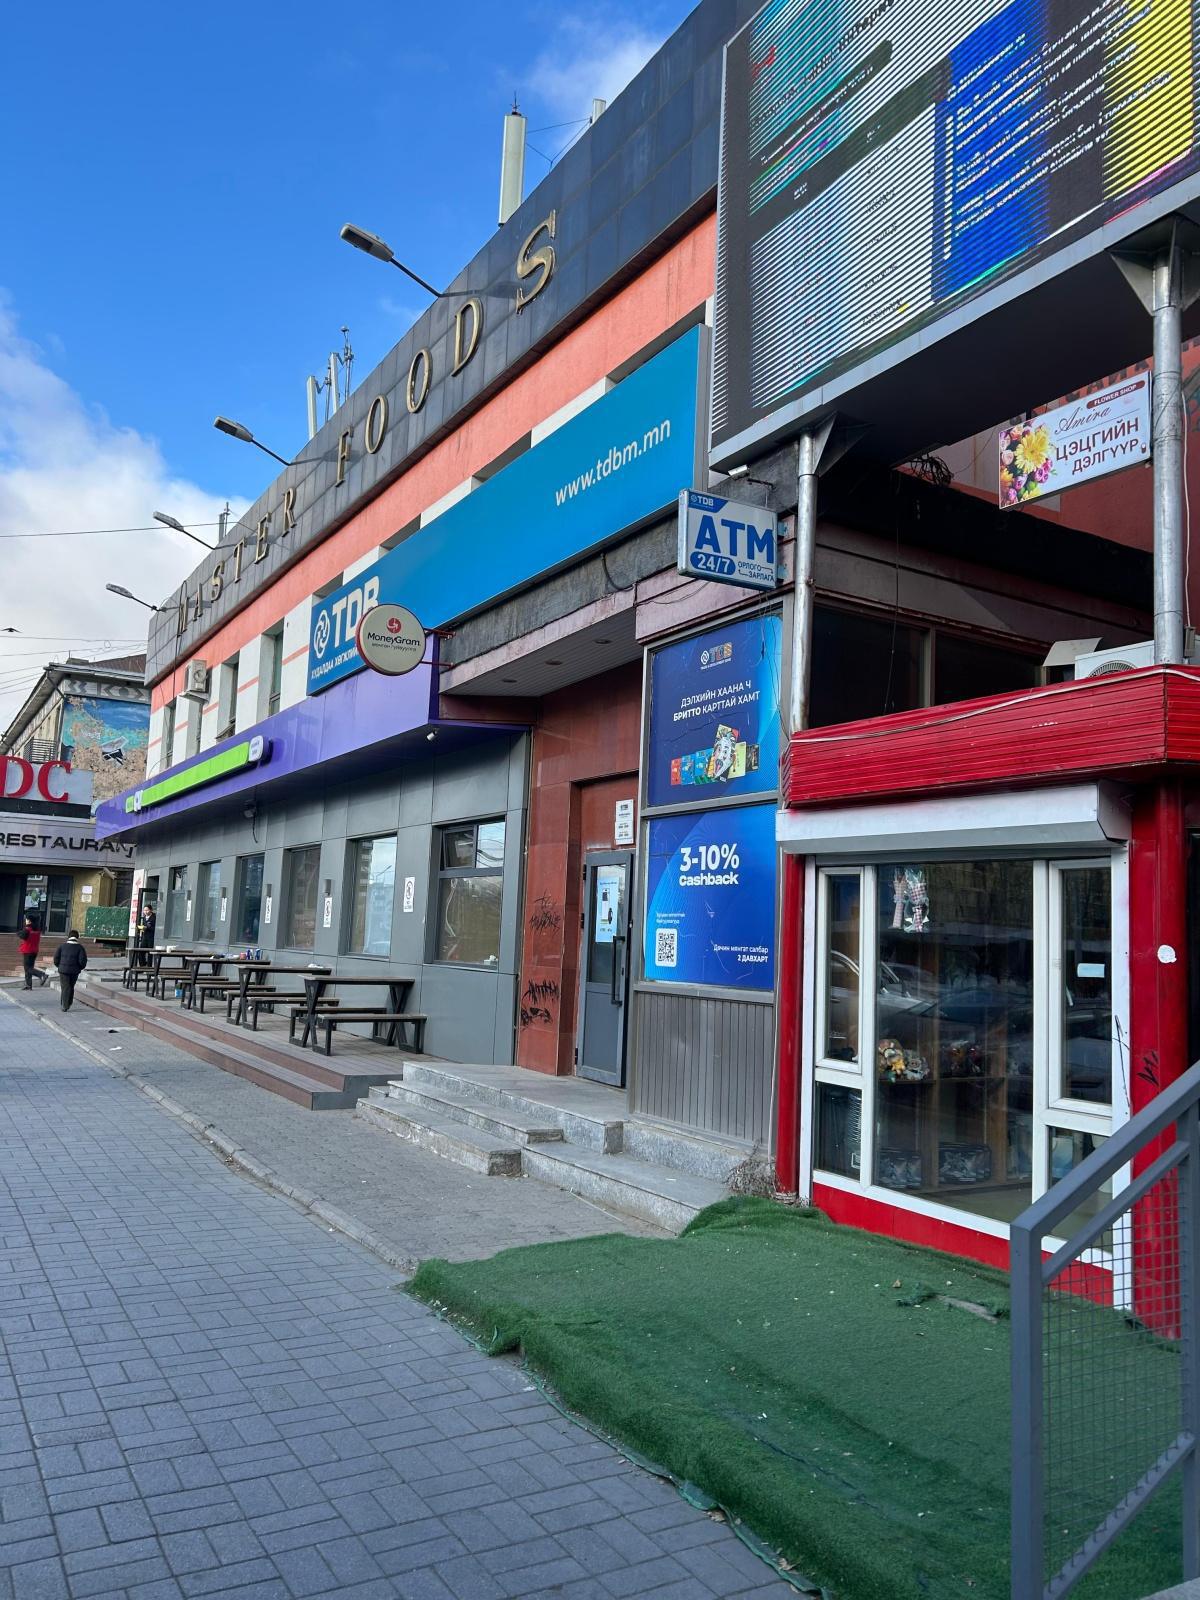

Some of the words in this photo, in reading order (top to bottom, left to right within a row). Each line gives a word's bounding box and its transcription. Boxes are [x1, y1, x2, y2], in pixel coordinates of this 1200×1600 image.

[335, 208, 557, 488] FOODS
[1093, 391, 1119, 406] FLOWER
[1118, 383, 1137, 397] SHOP
[1054, 406, 1113, 435] Amira
[1055, 416, 1139, 462] ЦЭЦГИЙН
[555, 419, 671, 507] www.tdbm.mn
[1071, 438, 1139, 476] ДЭЛГҮҮР
[698, 495, 714, 507] TDB
[694, 514, 775, 564] ATM
[697, 553, 731, 573] 24/7
[737, 561, 762, 572] ОРЛОГО
[748, 571, 775, 581] ЗАРЛАГА
[367, 632, 421, 646] MoneyGram
[673, 705, 701, 722] БРИТТО
[702, 696, 736, 714] КАРТТАЙ
[738, 691, 760, 705] ХАМТ
[681, 690, 716, 708] ДЭЛХИЙН
[717, 683, 744, 697] ХААНА
[745, 680, 751, 688] Ч
[679, 843, 740, 872] 3-10%
[679, 872, 739, 886] cashback
